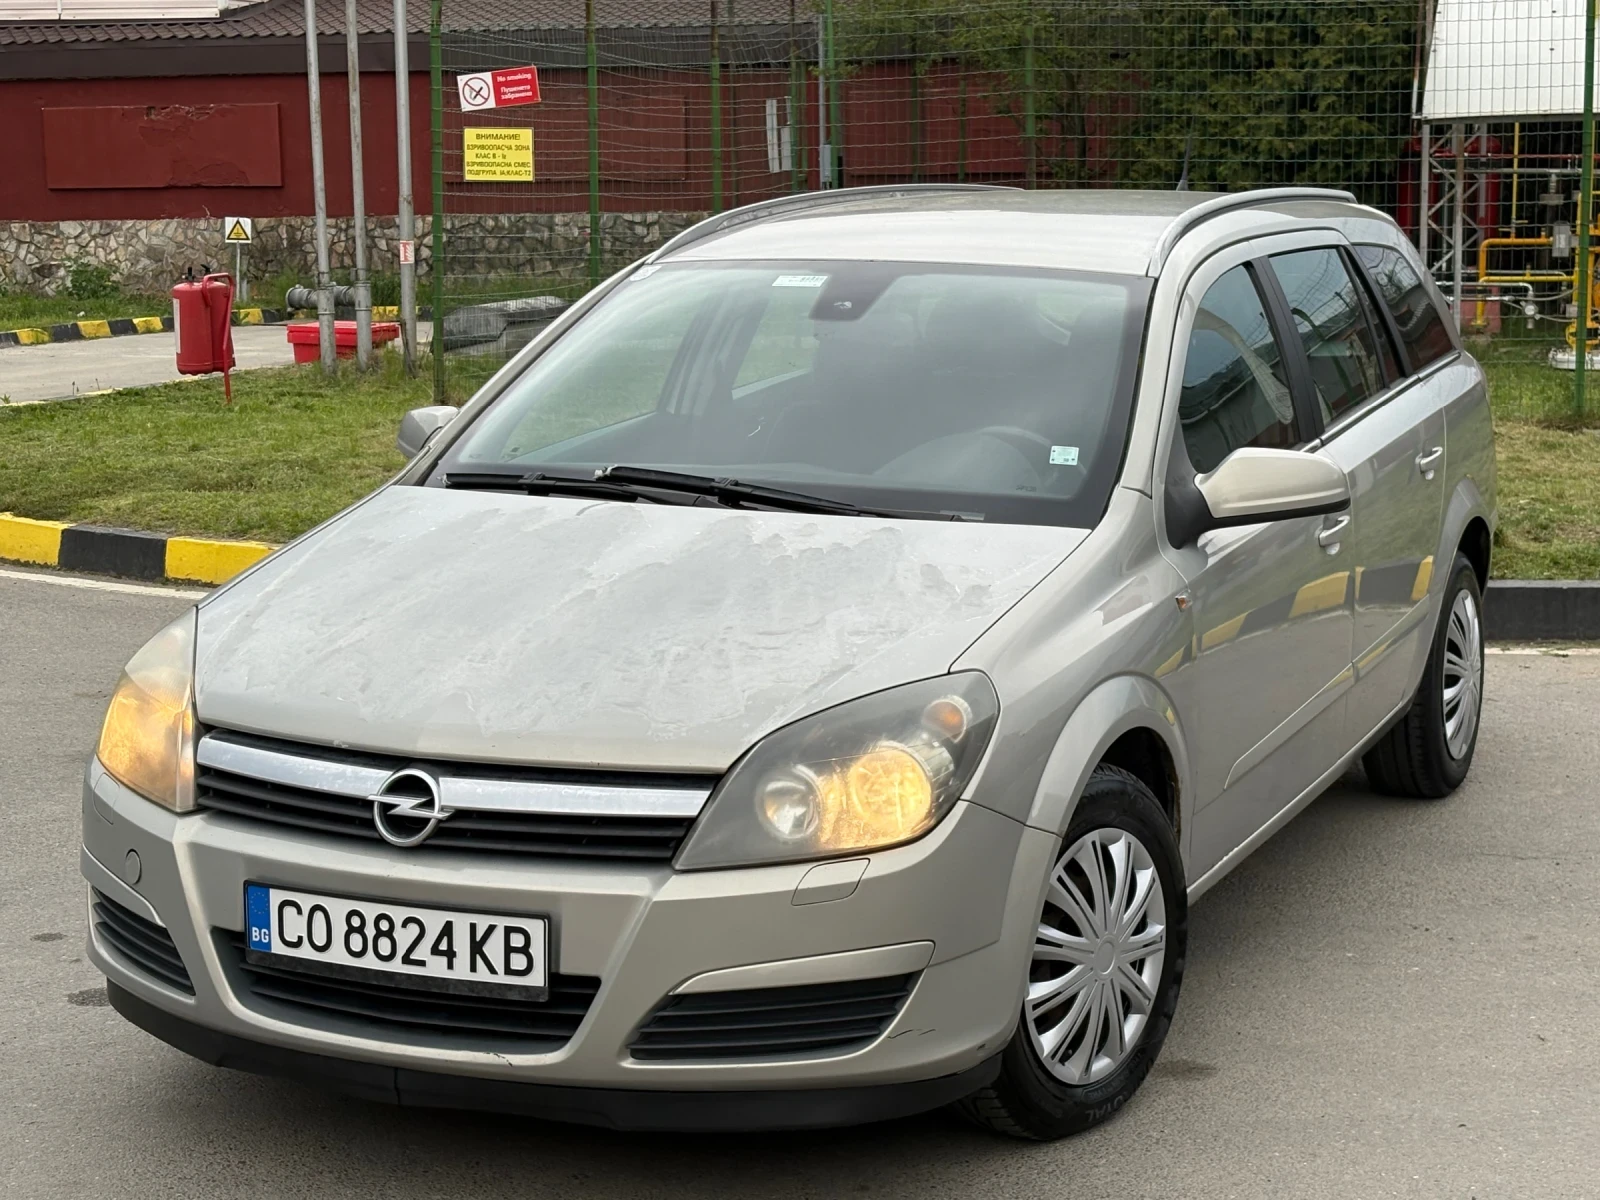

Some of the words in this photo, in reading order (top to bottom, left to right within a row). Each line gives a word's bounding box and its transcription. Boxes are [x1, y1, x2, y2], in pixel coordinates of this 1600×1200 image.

[507, 73, 532, 81] smoking
[500, 84, 531, 93] Пушенето
[475, 133, 521, 141] ВНИМАНИЕ!
[251, 926, 269, 943] BG
[343, 908, 458, 971] 8824
[468, 921, 535, 977] KB
